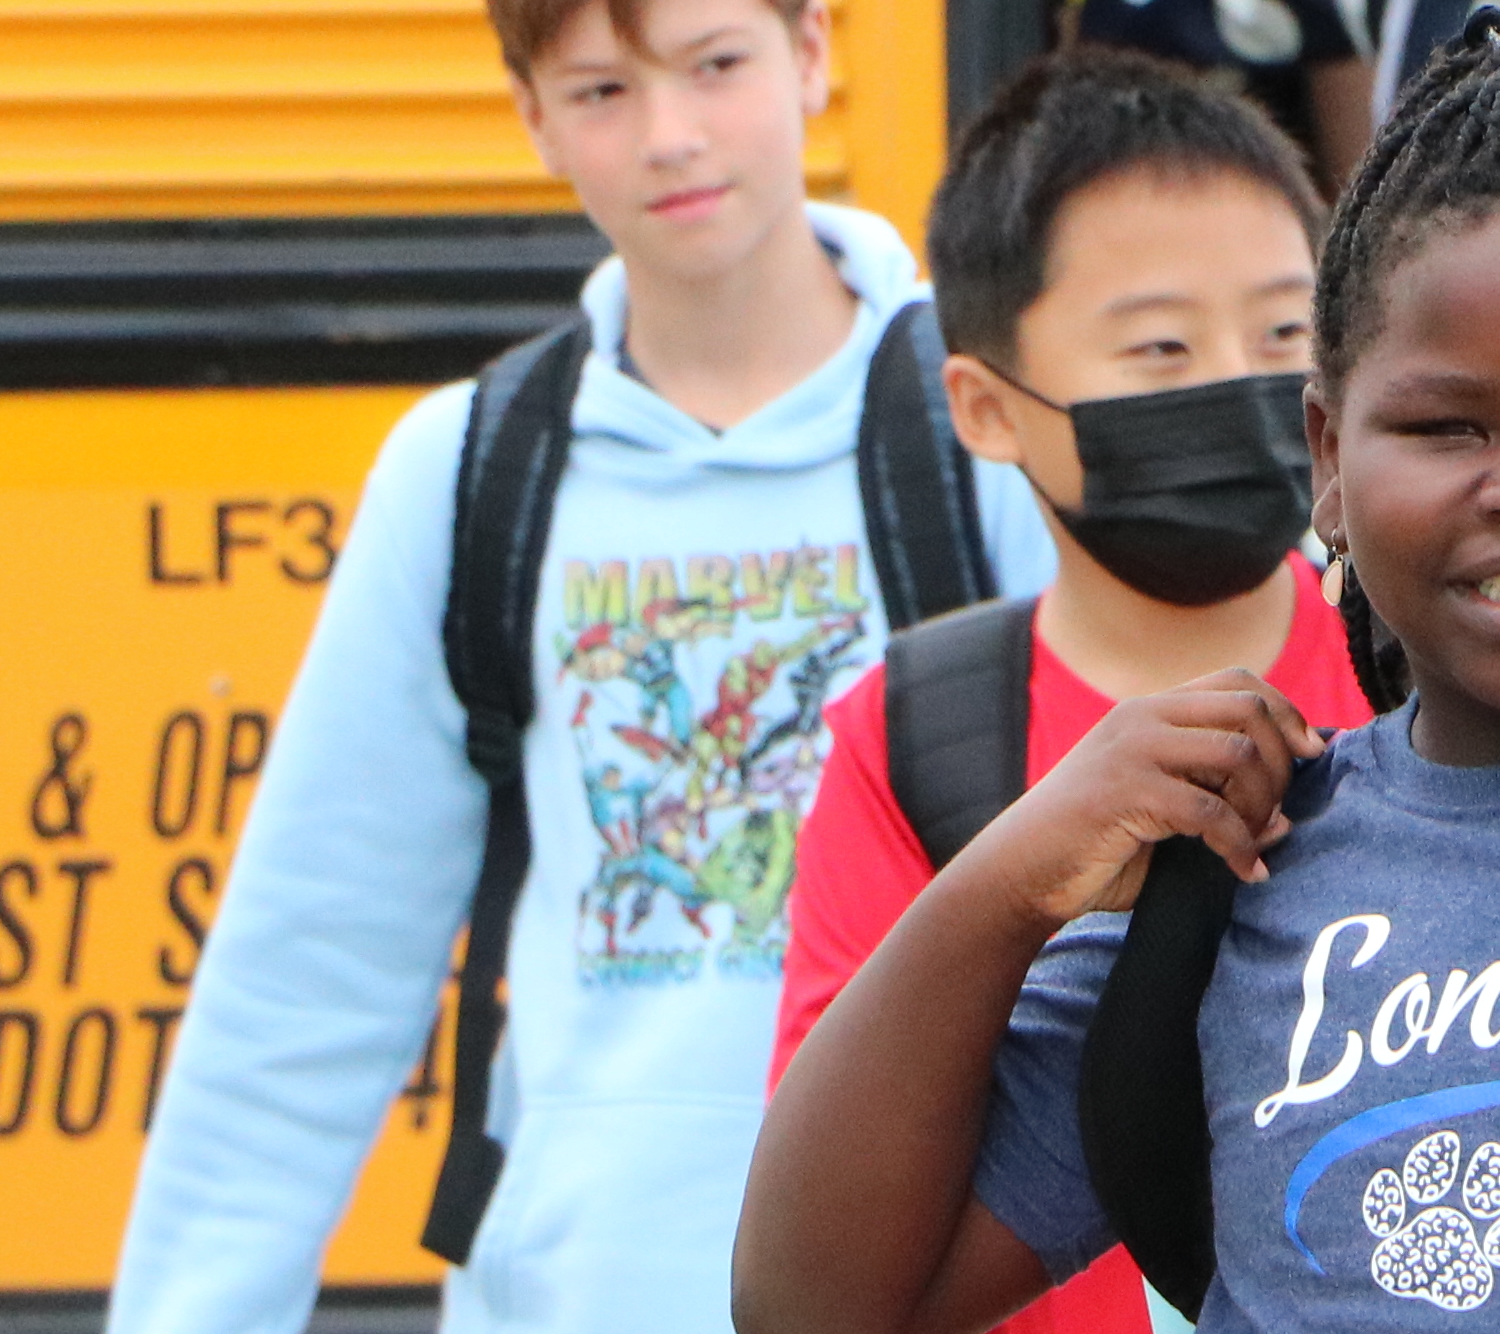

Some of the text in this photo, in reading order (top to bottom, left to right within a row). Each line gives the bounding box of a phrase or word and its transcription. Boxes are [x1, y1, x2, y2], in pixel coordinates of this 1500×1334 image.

[145, 497, 338, 587] LF3
[562, 544, 869, 629] MARVEL
[28, 711, 93, 841] &
[152, 711, 268, 839] OP
[158, 854, 216, 989] S
